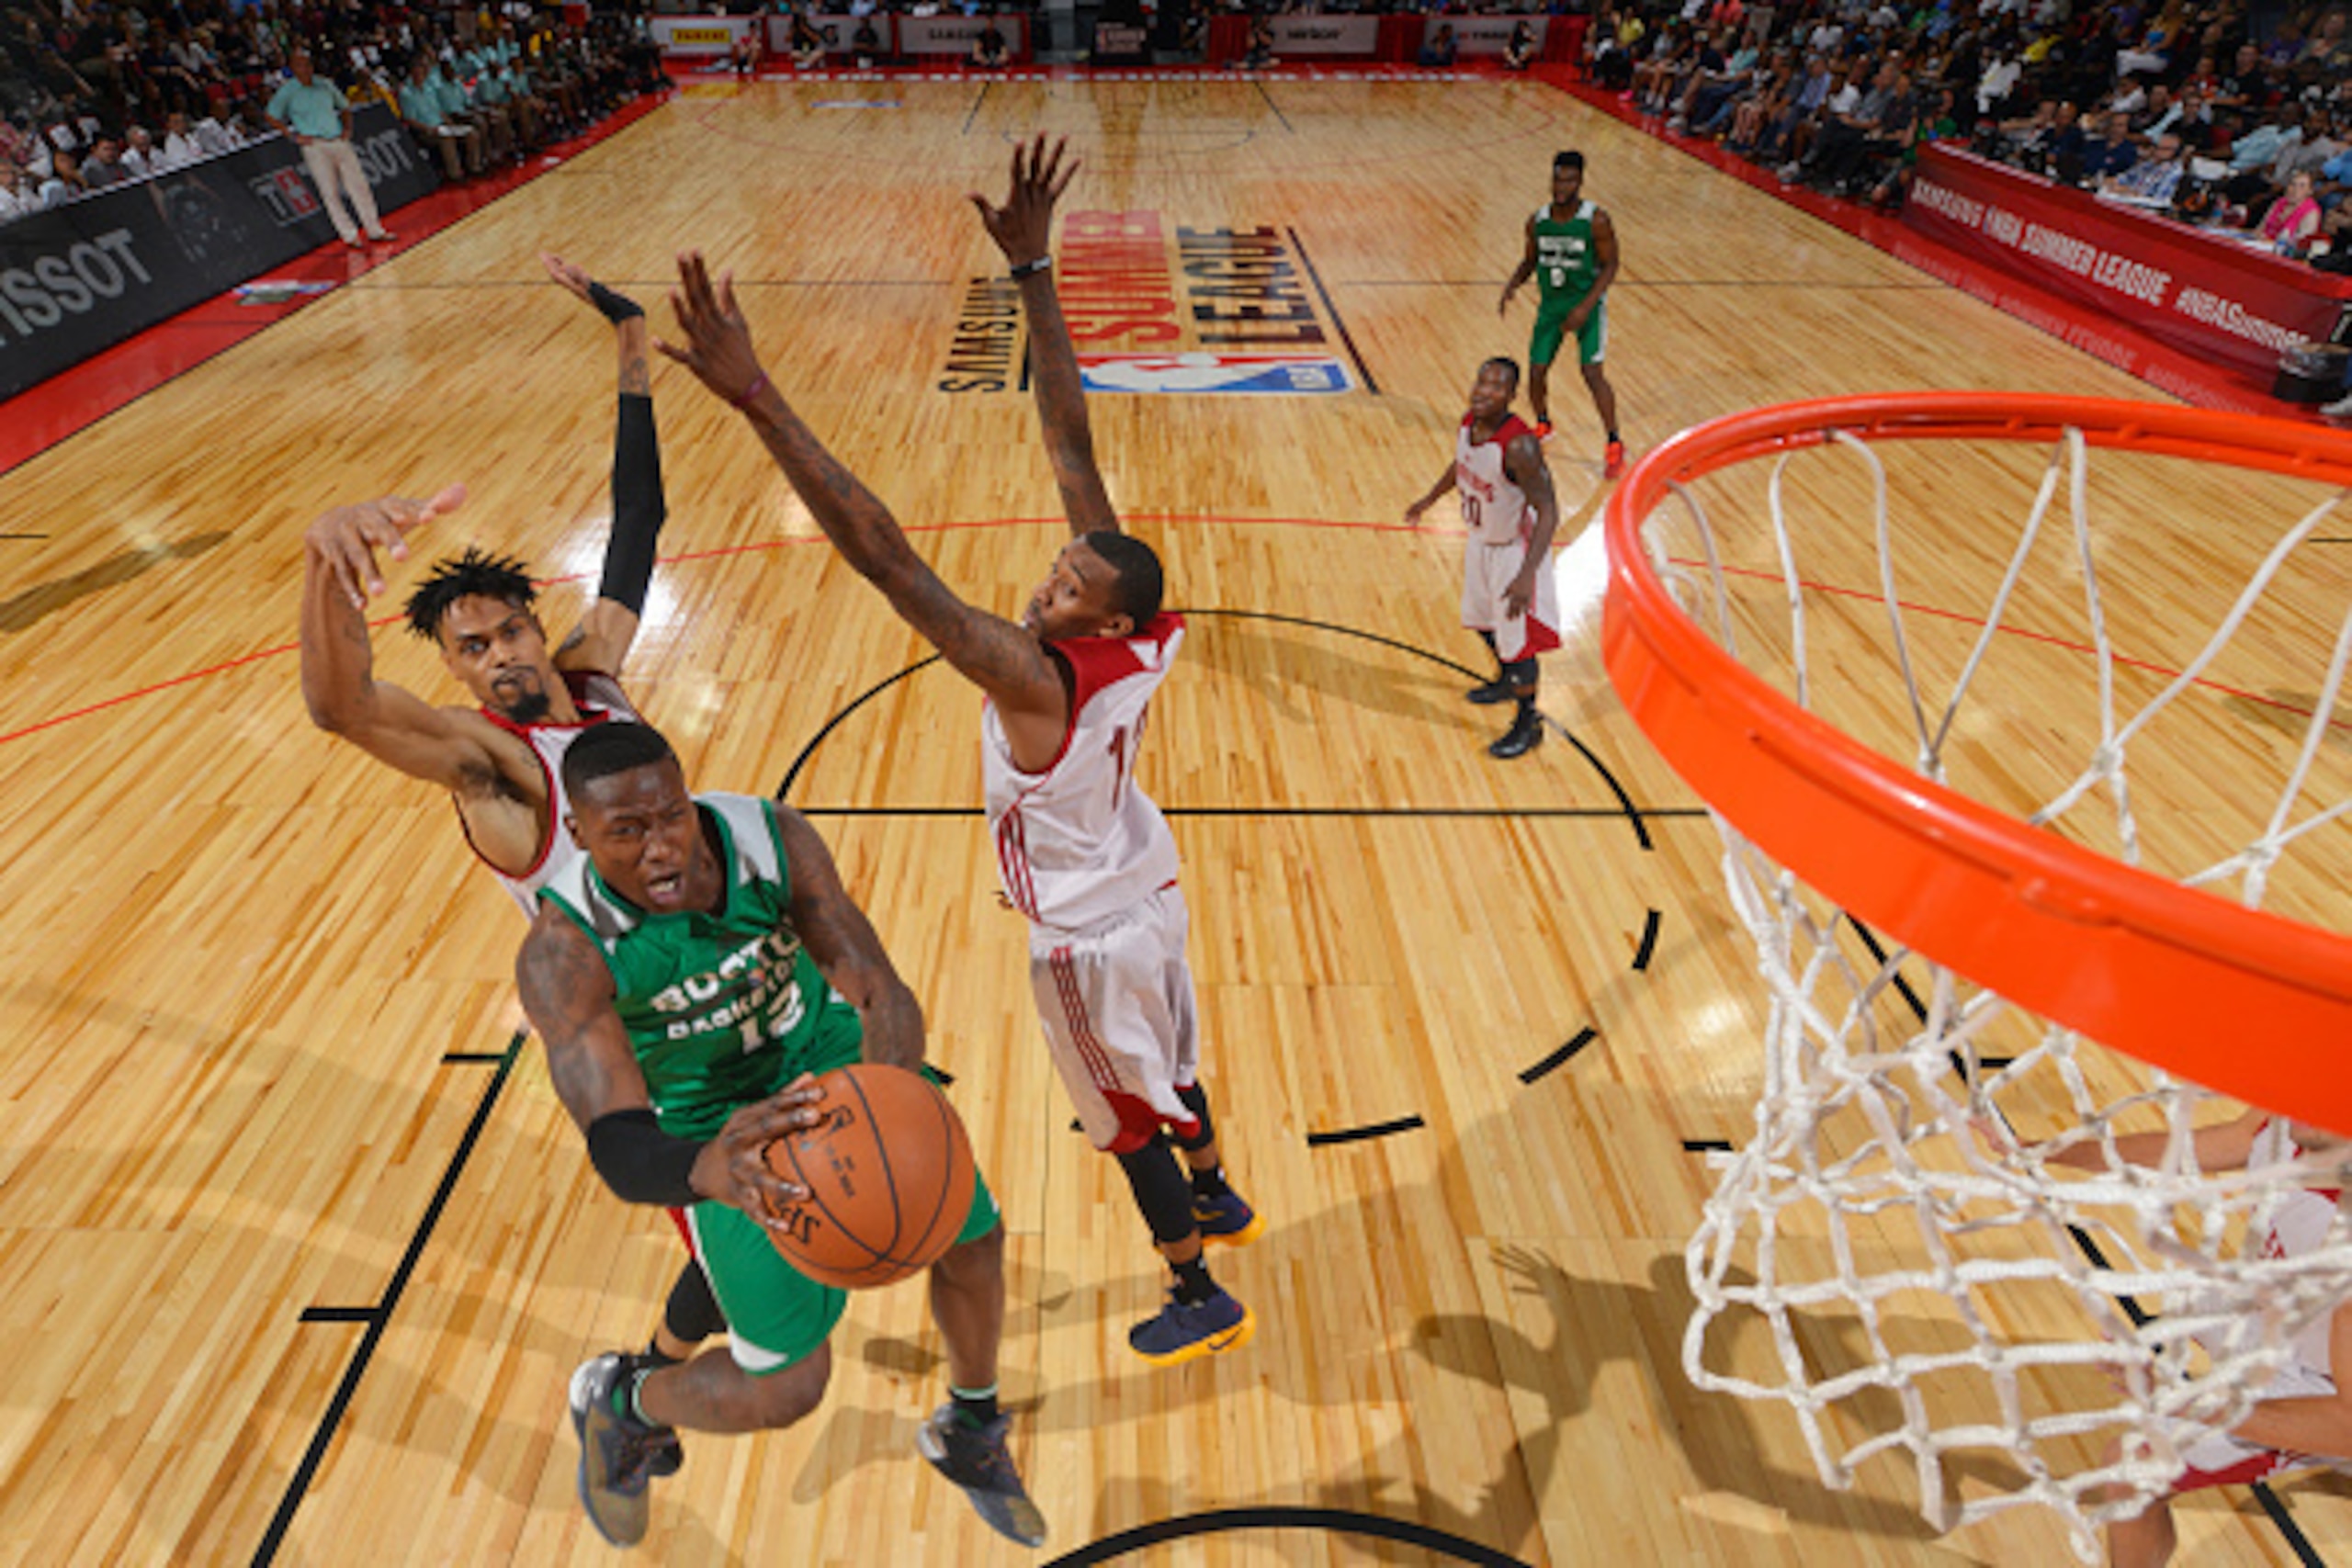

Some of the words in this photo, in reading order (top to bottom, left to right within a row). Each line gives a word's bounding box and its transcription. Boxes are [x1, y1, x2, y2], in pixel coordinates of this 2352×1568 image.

[0, 228, 153, 347] ISSOT
[1176, 226, 1327, 344] LEAGUE
[2020, 223, 2098, 276] SUMMER
[2092, 251, 2172, 306] LEAGUE
